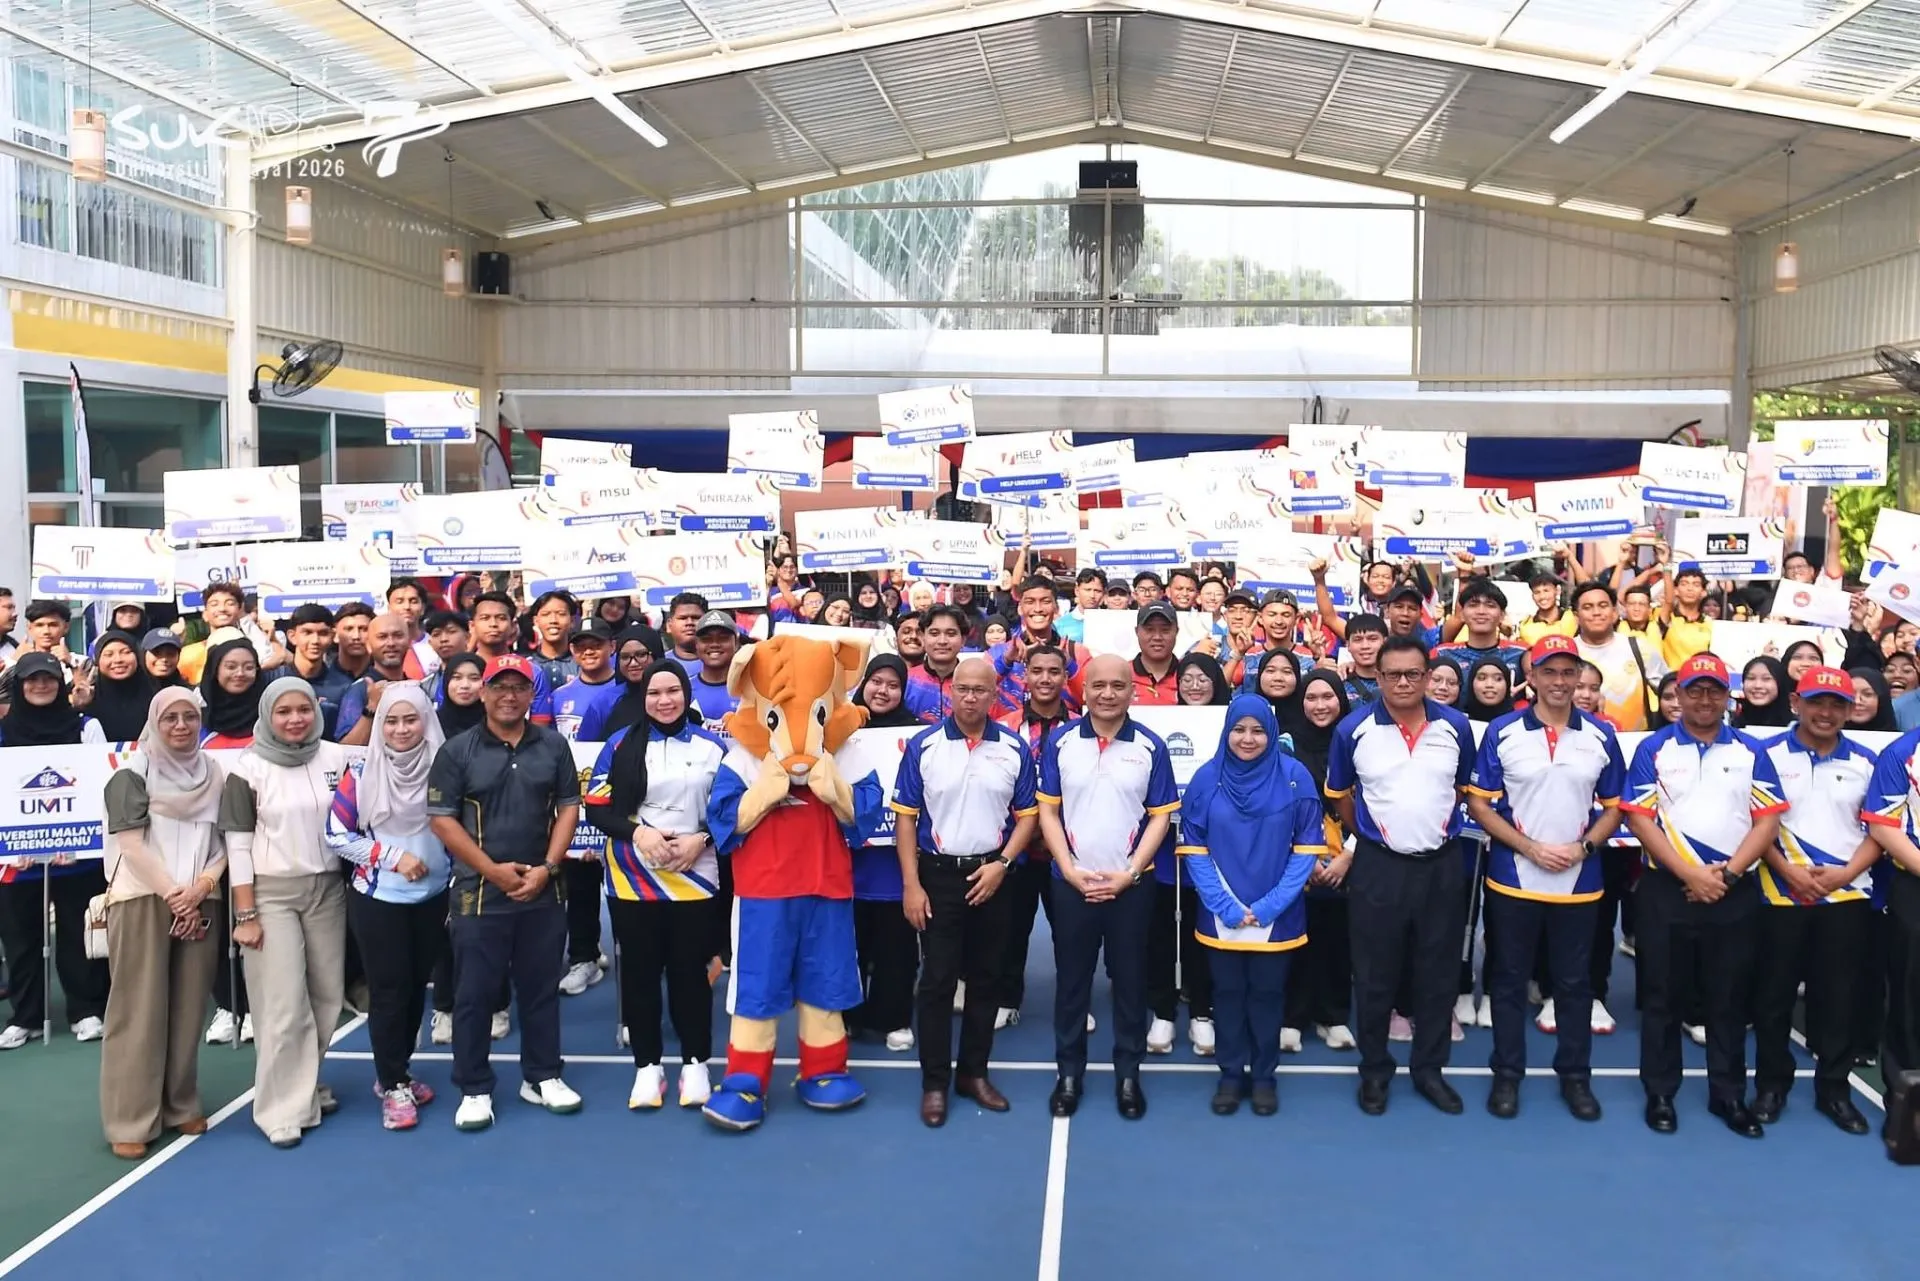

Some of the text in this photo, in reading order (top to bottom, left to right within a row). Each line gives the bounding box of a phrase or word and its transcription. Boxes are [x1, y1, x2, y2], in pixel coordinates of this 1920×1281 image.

[1015, 449, 1041, 461] HELP
[1000, 478, 1048, 488] HELP UNIVERSITY
[599, 487, 630, 499] msu
[700, 493, 753, 503] UNIRAZAK
[1576, 496, 1614, 511] MMU
[826, 527, 877, 541] UNITAR
[690, 554, 728, 571] UTM
[20, 796, 77, 815] UMT
[5, 834, 91, 851] TERENGGANU
